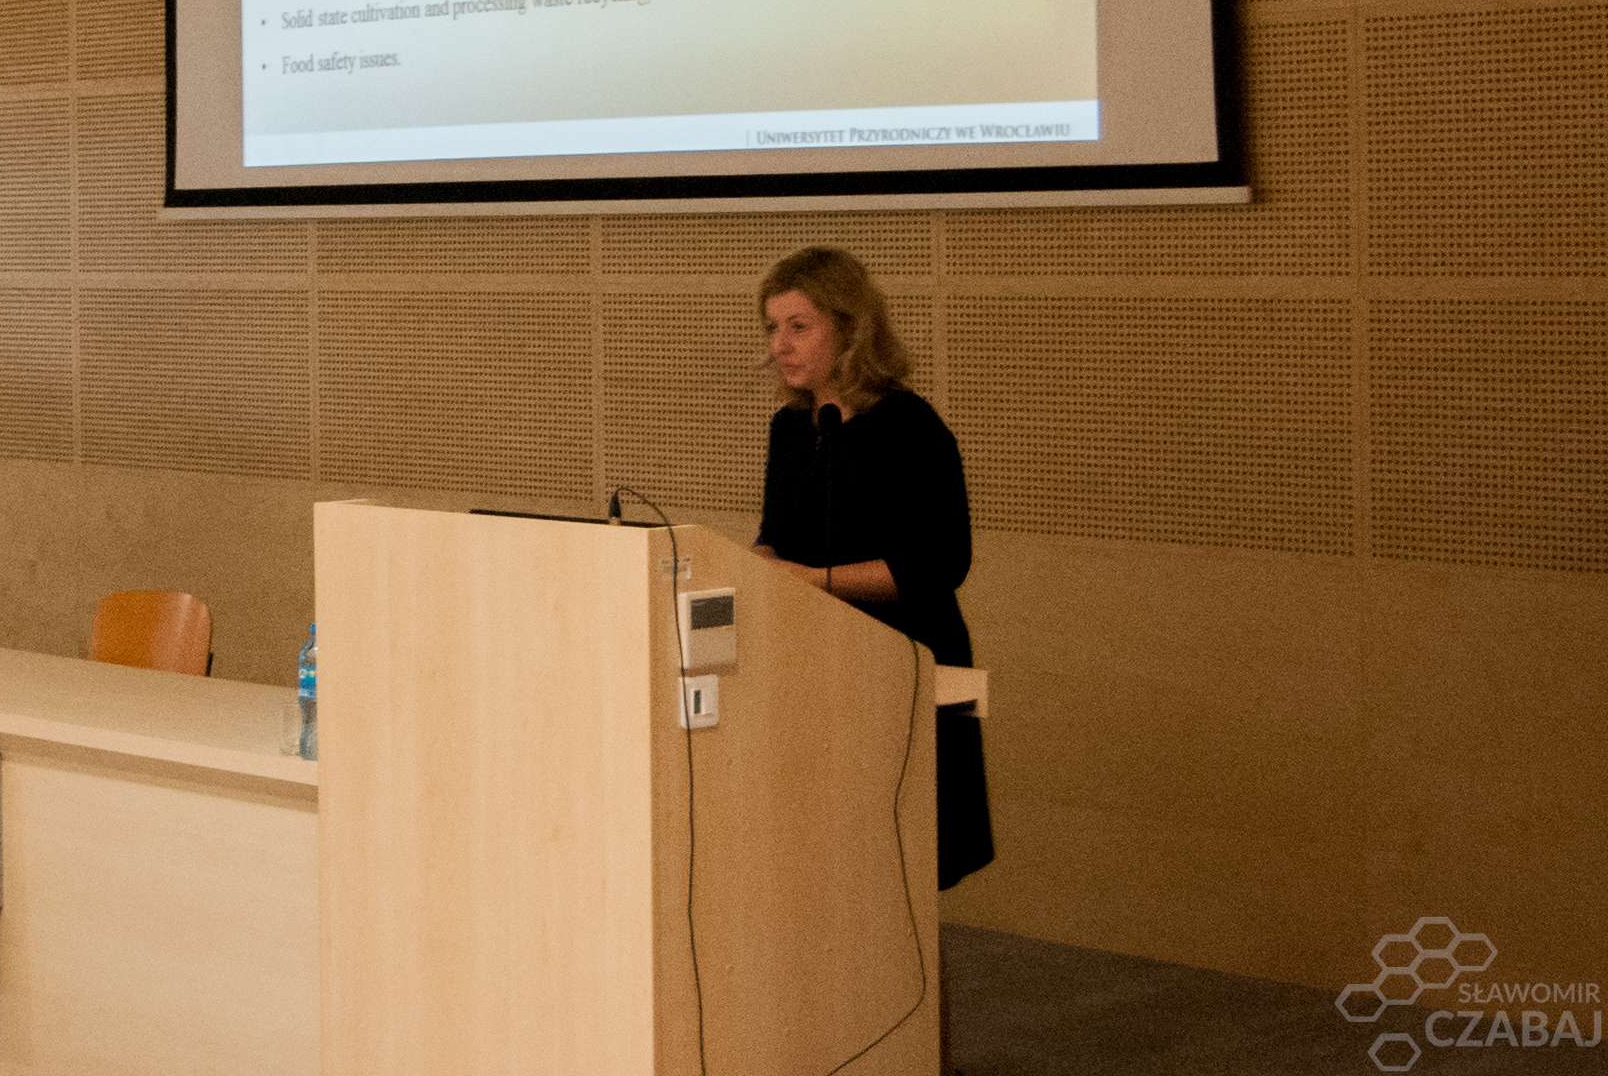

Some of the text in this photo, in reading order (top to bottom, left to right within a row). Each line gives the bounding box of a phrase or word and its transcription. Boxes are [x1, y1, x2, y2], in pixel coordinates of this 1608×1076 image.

[281, 8, 313, 29] Solid
[318, 10, 348, 26] state
[350, 0, 420, 23] cultivation
[282, 53, 314, 74] Food
[317, 51, 356, 74] safety
